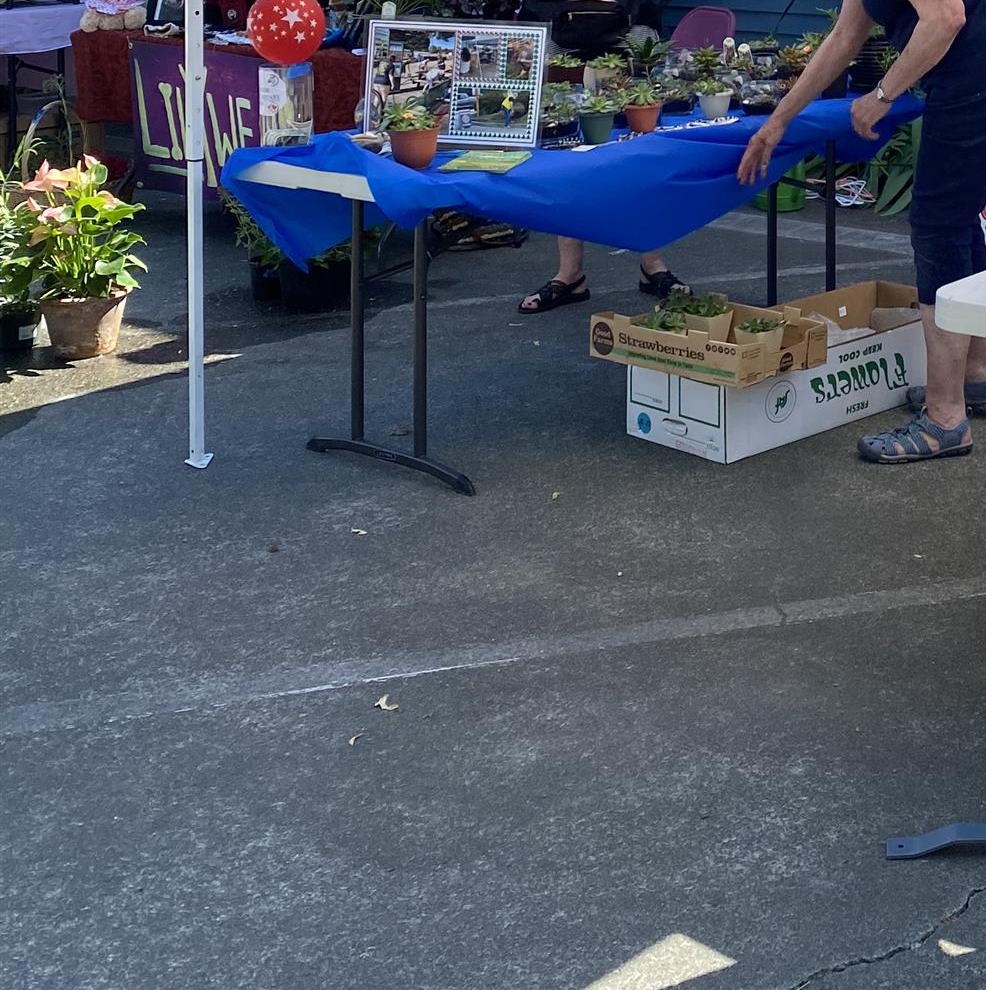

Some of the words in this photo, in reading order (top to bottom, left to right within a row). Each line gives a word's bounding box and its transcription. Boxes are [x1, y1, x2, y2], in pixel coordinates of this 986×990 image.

[618, 332, 705, 361] Strawberries
[863, 342, 883, 357] KEEP
[839, 350, 861, 364] COOL
[810, 352, 910, 404] Flowers
[846, 399, 869, 415] FRESH
